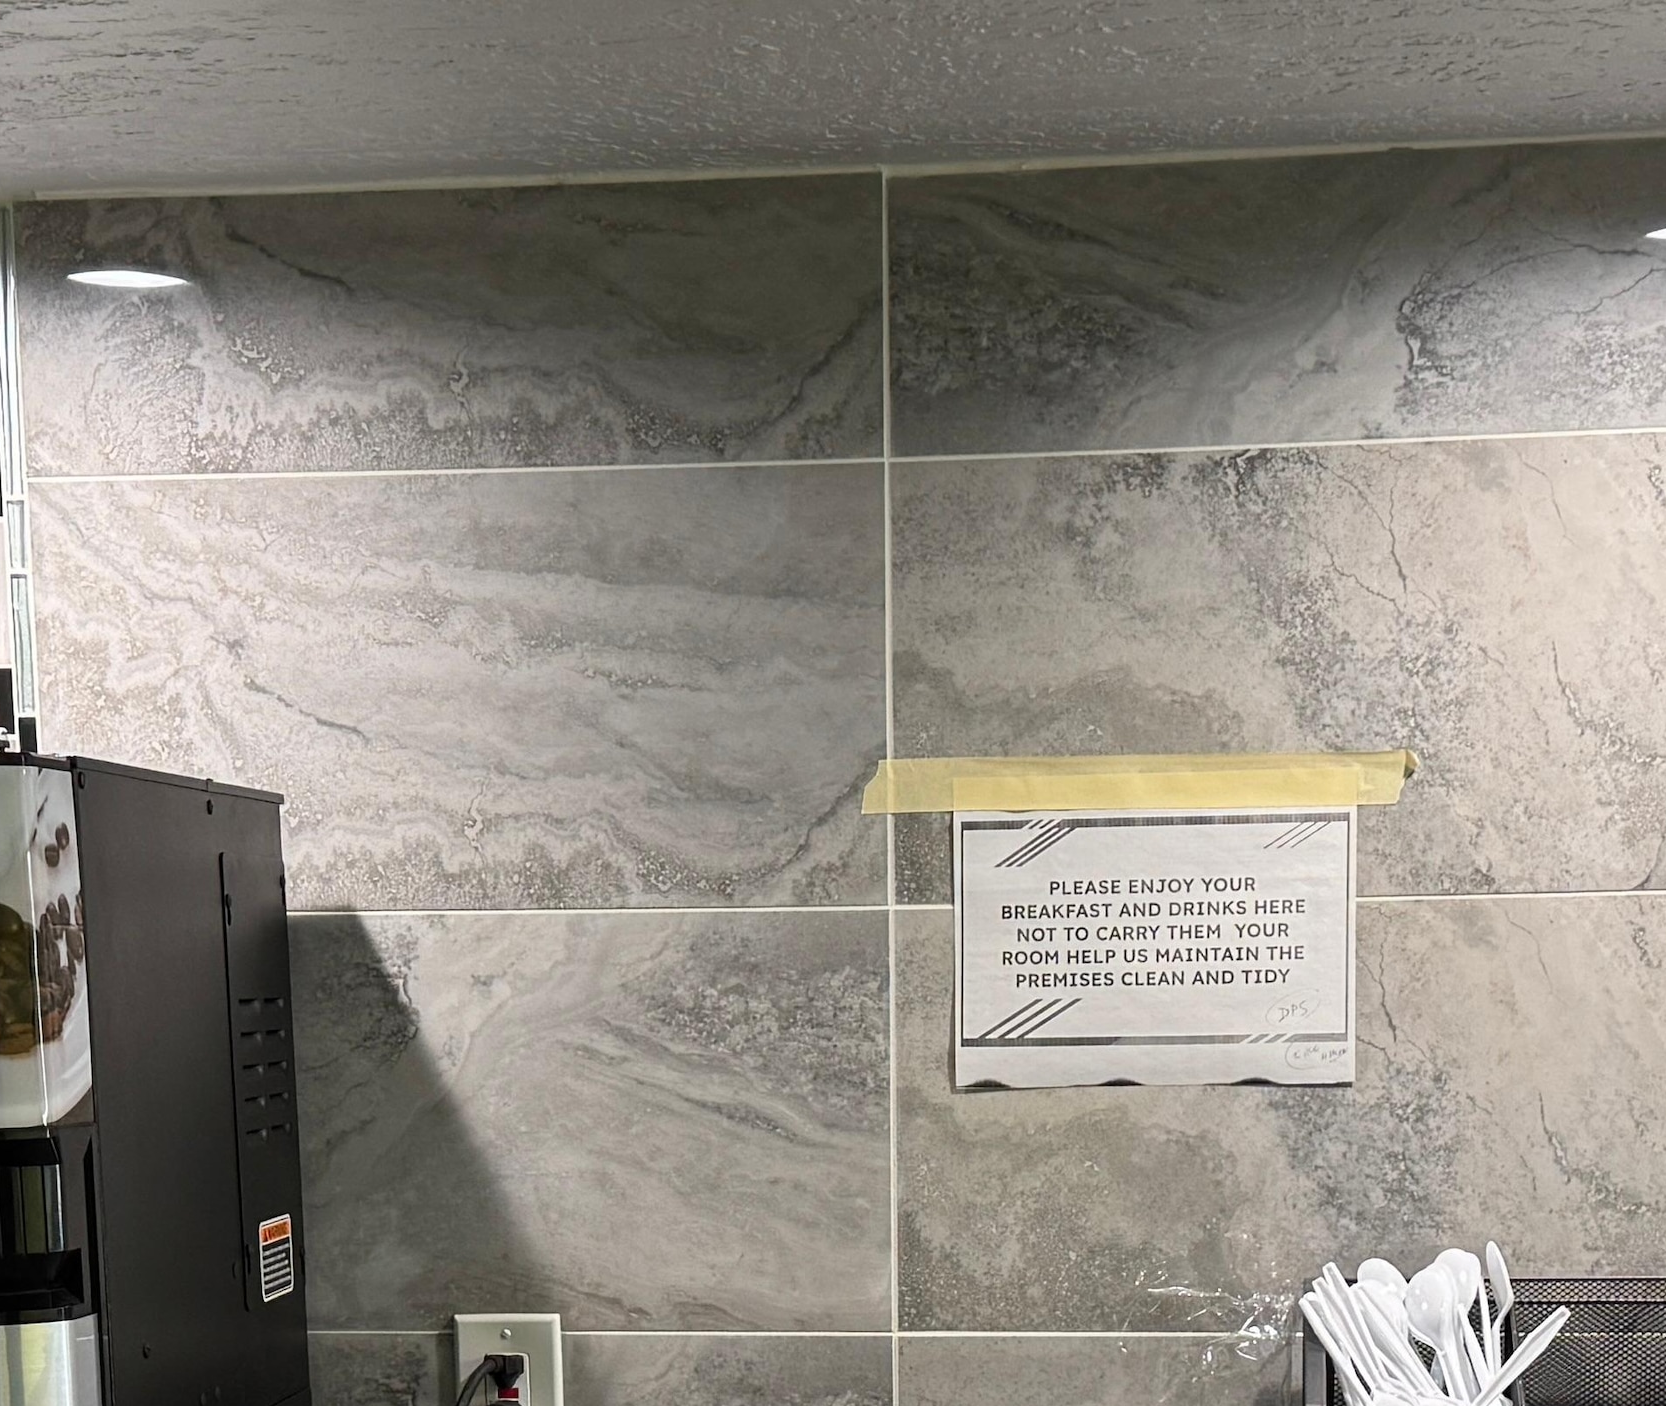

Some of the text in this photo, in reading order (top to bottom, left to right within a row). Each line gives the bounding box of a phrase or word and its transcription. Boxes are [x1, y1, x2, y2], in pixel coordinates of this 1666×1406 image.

[1050, 878, 1254, 895] PLEASE ENJOY YOUR
[1002, 900, 1304, 919] BREAKFAST AND DRINKS HERE
[1018, 924, 1288, 941] NOT TO CARRY THEM YOUR
[1003, 946, 1303, 965] ROOM HELP US MAINTAIN THE
[1017, 969, 1289, 987] PREMISES CLEAN AND TIDY
